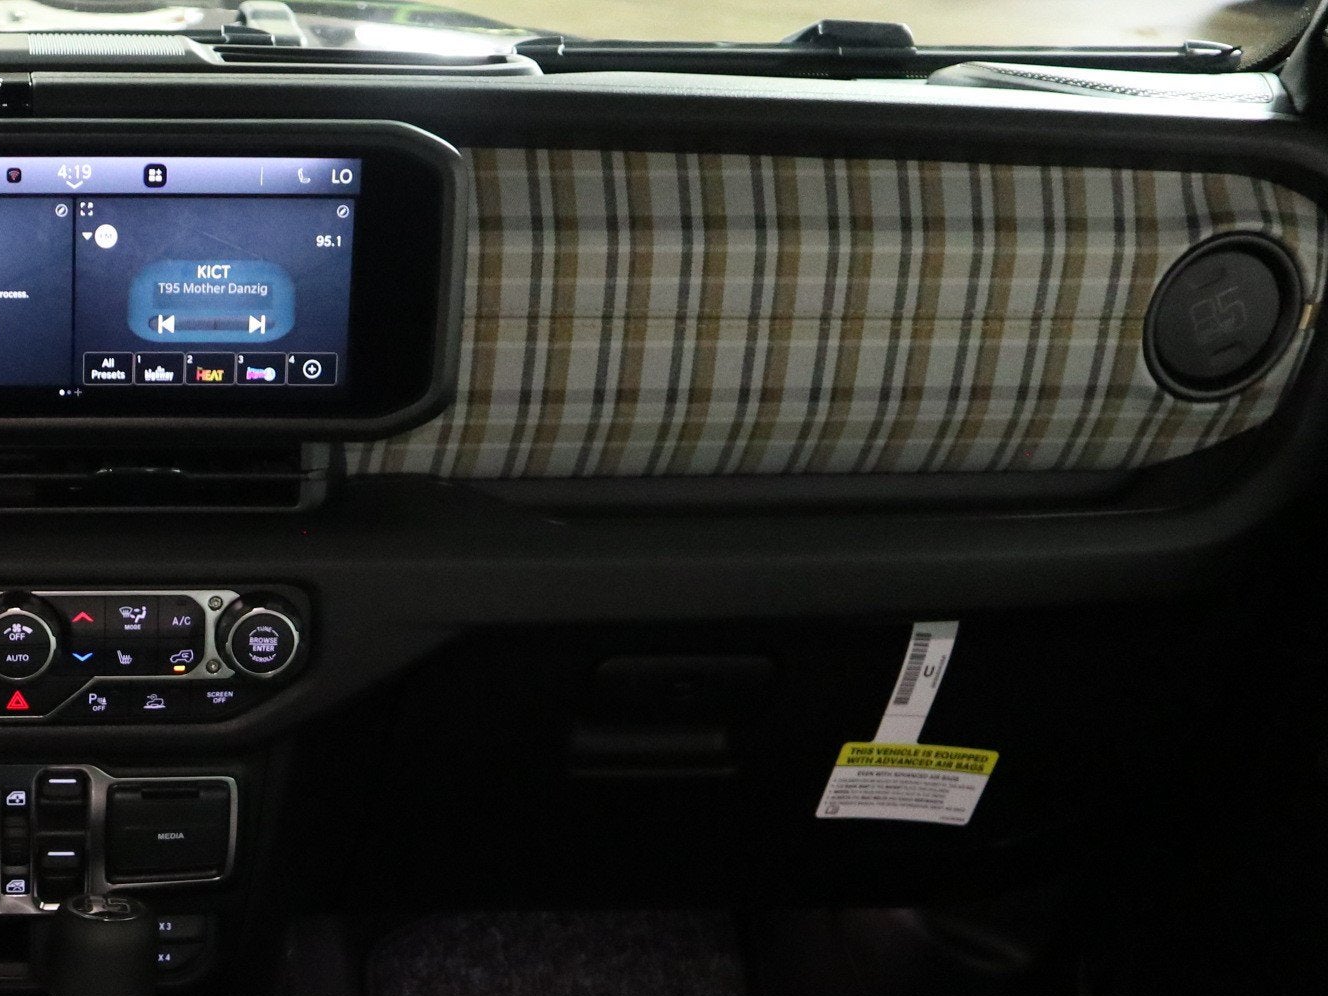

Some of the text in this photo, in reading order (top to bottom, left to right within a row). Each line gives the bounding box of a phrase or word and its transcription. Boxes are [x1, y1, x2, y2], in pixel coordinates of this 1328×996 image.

[57, 163, 92, 180] 4:19
[331, 169, 353, 184] LO
[316, 235, 342, 247] 95.1
[197, 265, 231, 279] KICT
[158, 283, 268, 297] T95 Mother Danzig
[102, 358, 115, 368] All
[137, 356, 141, 364] 1
[187, 356, 193, 364] 2
[238, 356, 244, 364] 3
[288, 356, 295, 364] 4
[91, 369, 126, 380] Presets
[196, 368, 224, 381] HEAT
[172, 616, 191, 626] A/C
[9, 633, 26, 641] OFF
[249, 636, 278, 644] BROWSE
[6, 654, 29, 662] AUTO
[876, 748, 919, 757] VEHICLE
[847, 756, 873, 765] WITH
[874, 757, 934, 767] ADVANCED
[157, 832, 185, 840] MEDIA
